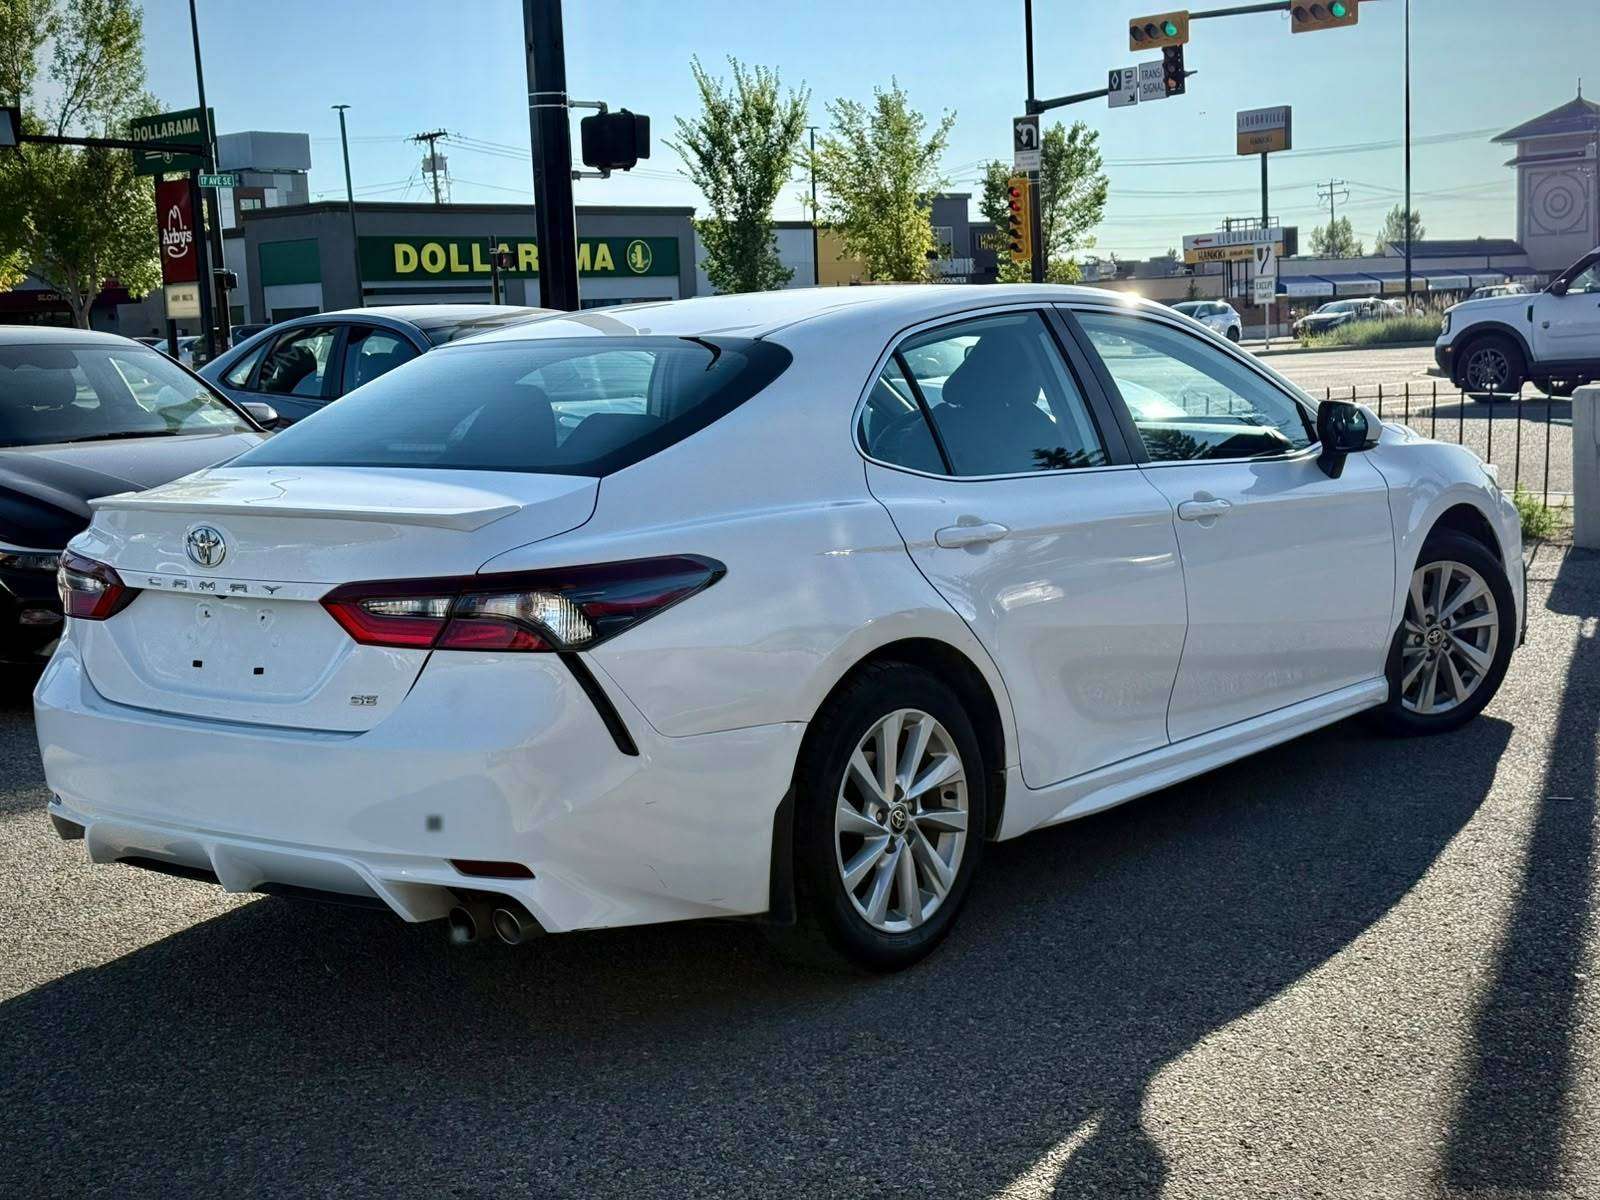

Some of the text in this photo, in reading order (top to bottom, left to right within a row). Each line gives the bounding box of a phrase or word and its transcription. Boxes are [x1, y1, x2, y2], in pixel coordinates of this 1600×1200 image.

[1141, 68, 1163, 80] TRANSI
[133, 117, 200, 142] DOLLARAMA
[200, 177, 232, 185] 17 AVE SE
[162, 225, 192, 248] Arby's
[1217, 230, 1272, 245] LIQUORVILLE
[393, 242, 614, 273] DOLLRMA
[148, 576, 282, 594] CAMRY
